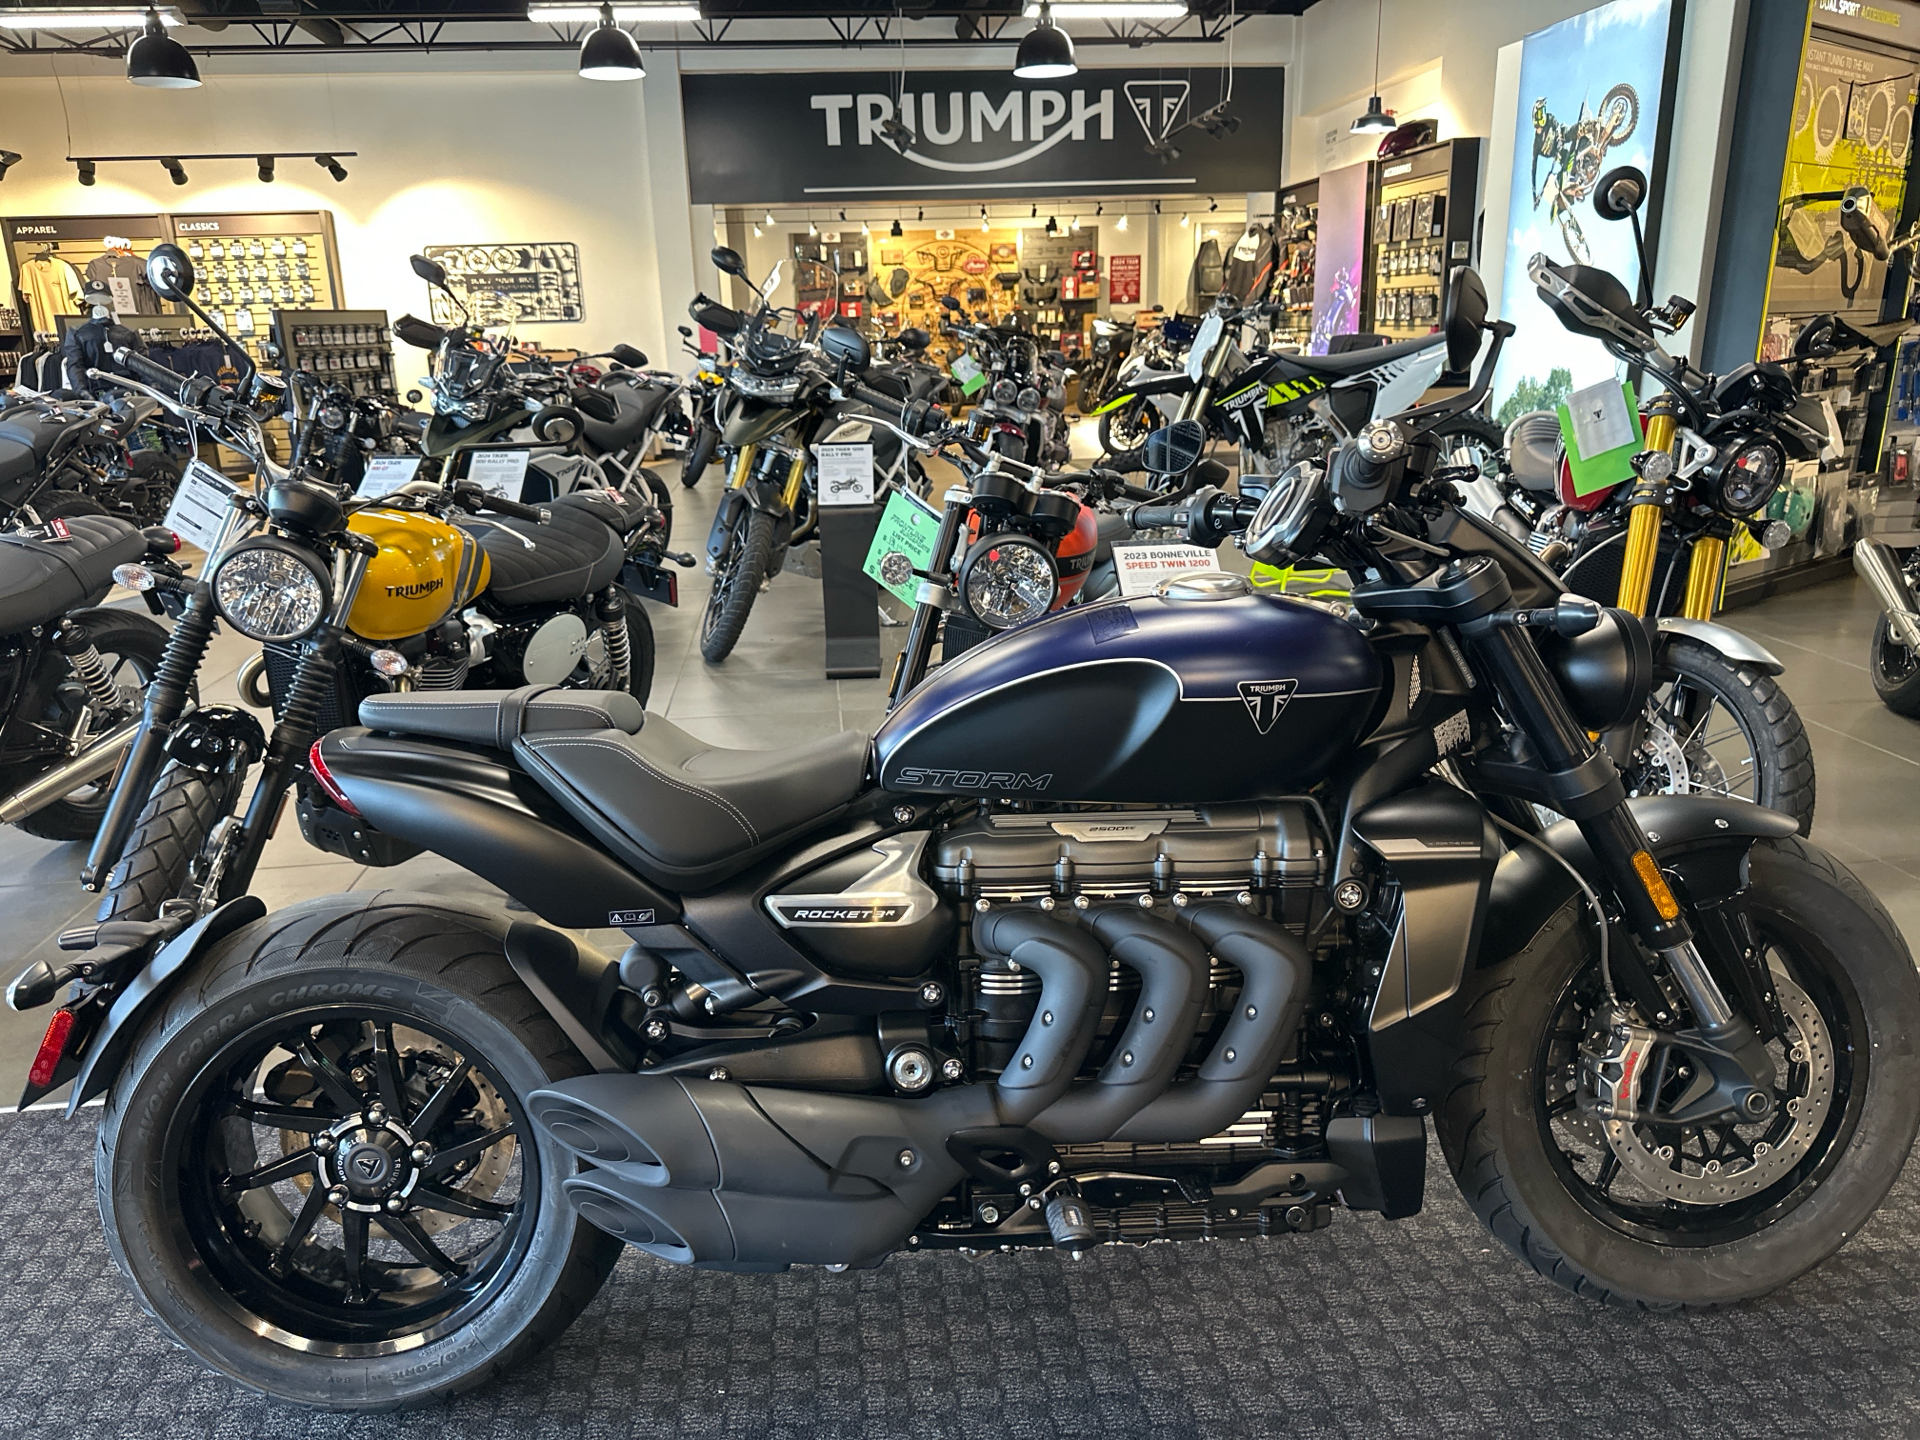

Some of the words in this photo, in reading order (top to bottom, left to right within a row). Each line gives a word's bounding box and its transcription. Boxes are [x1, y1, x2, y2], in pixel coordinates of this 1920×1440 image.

[810, 89, 1114, 172] TRIUMPH
[16, 226, 57, 235] APPAREL
[179, 222, 219, 231] CLASSICS
[1223, 386, 1263, 411] TRIUMPH
[556, 460, 584, 477] TIGER
[905, 540, 922, 555] PRICE
[1124, 552, 1148, 560] 2023
[1150, 550, 1211, 559] BONNEVILLE
[1125, 561, 1158, 570] SPEED
[1161, 561, 1186, 569] TWIN
[1189, 559, 1211, 567] 1200
[385, 578, 444, 600] TRIUMPH
[1249, 682, 1287, 695] TRIUMPH
[895, 767, 1053, 791] STORM
[138, 1072, 175, 1139] AVON
[177, 1003, 256, 1068] COBRA
[267, 982, 400, 1008] CHROME
[337, 1135, 364, 1182] MOTORCCLES
[381, 1157, 402, 1191] TRIUMPH
